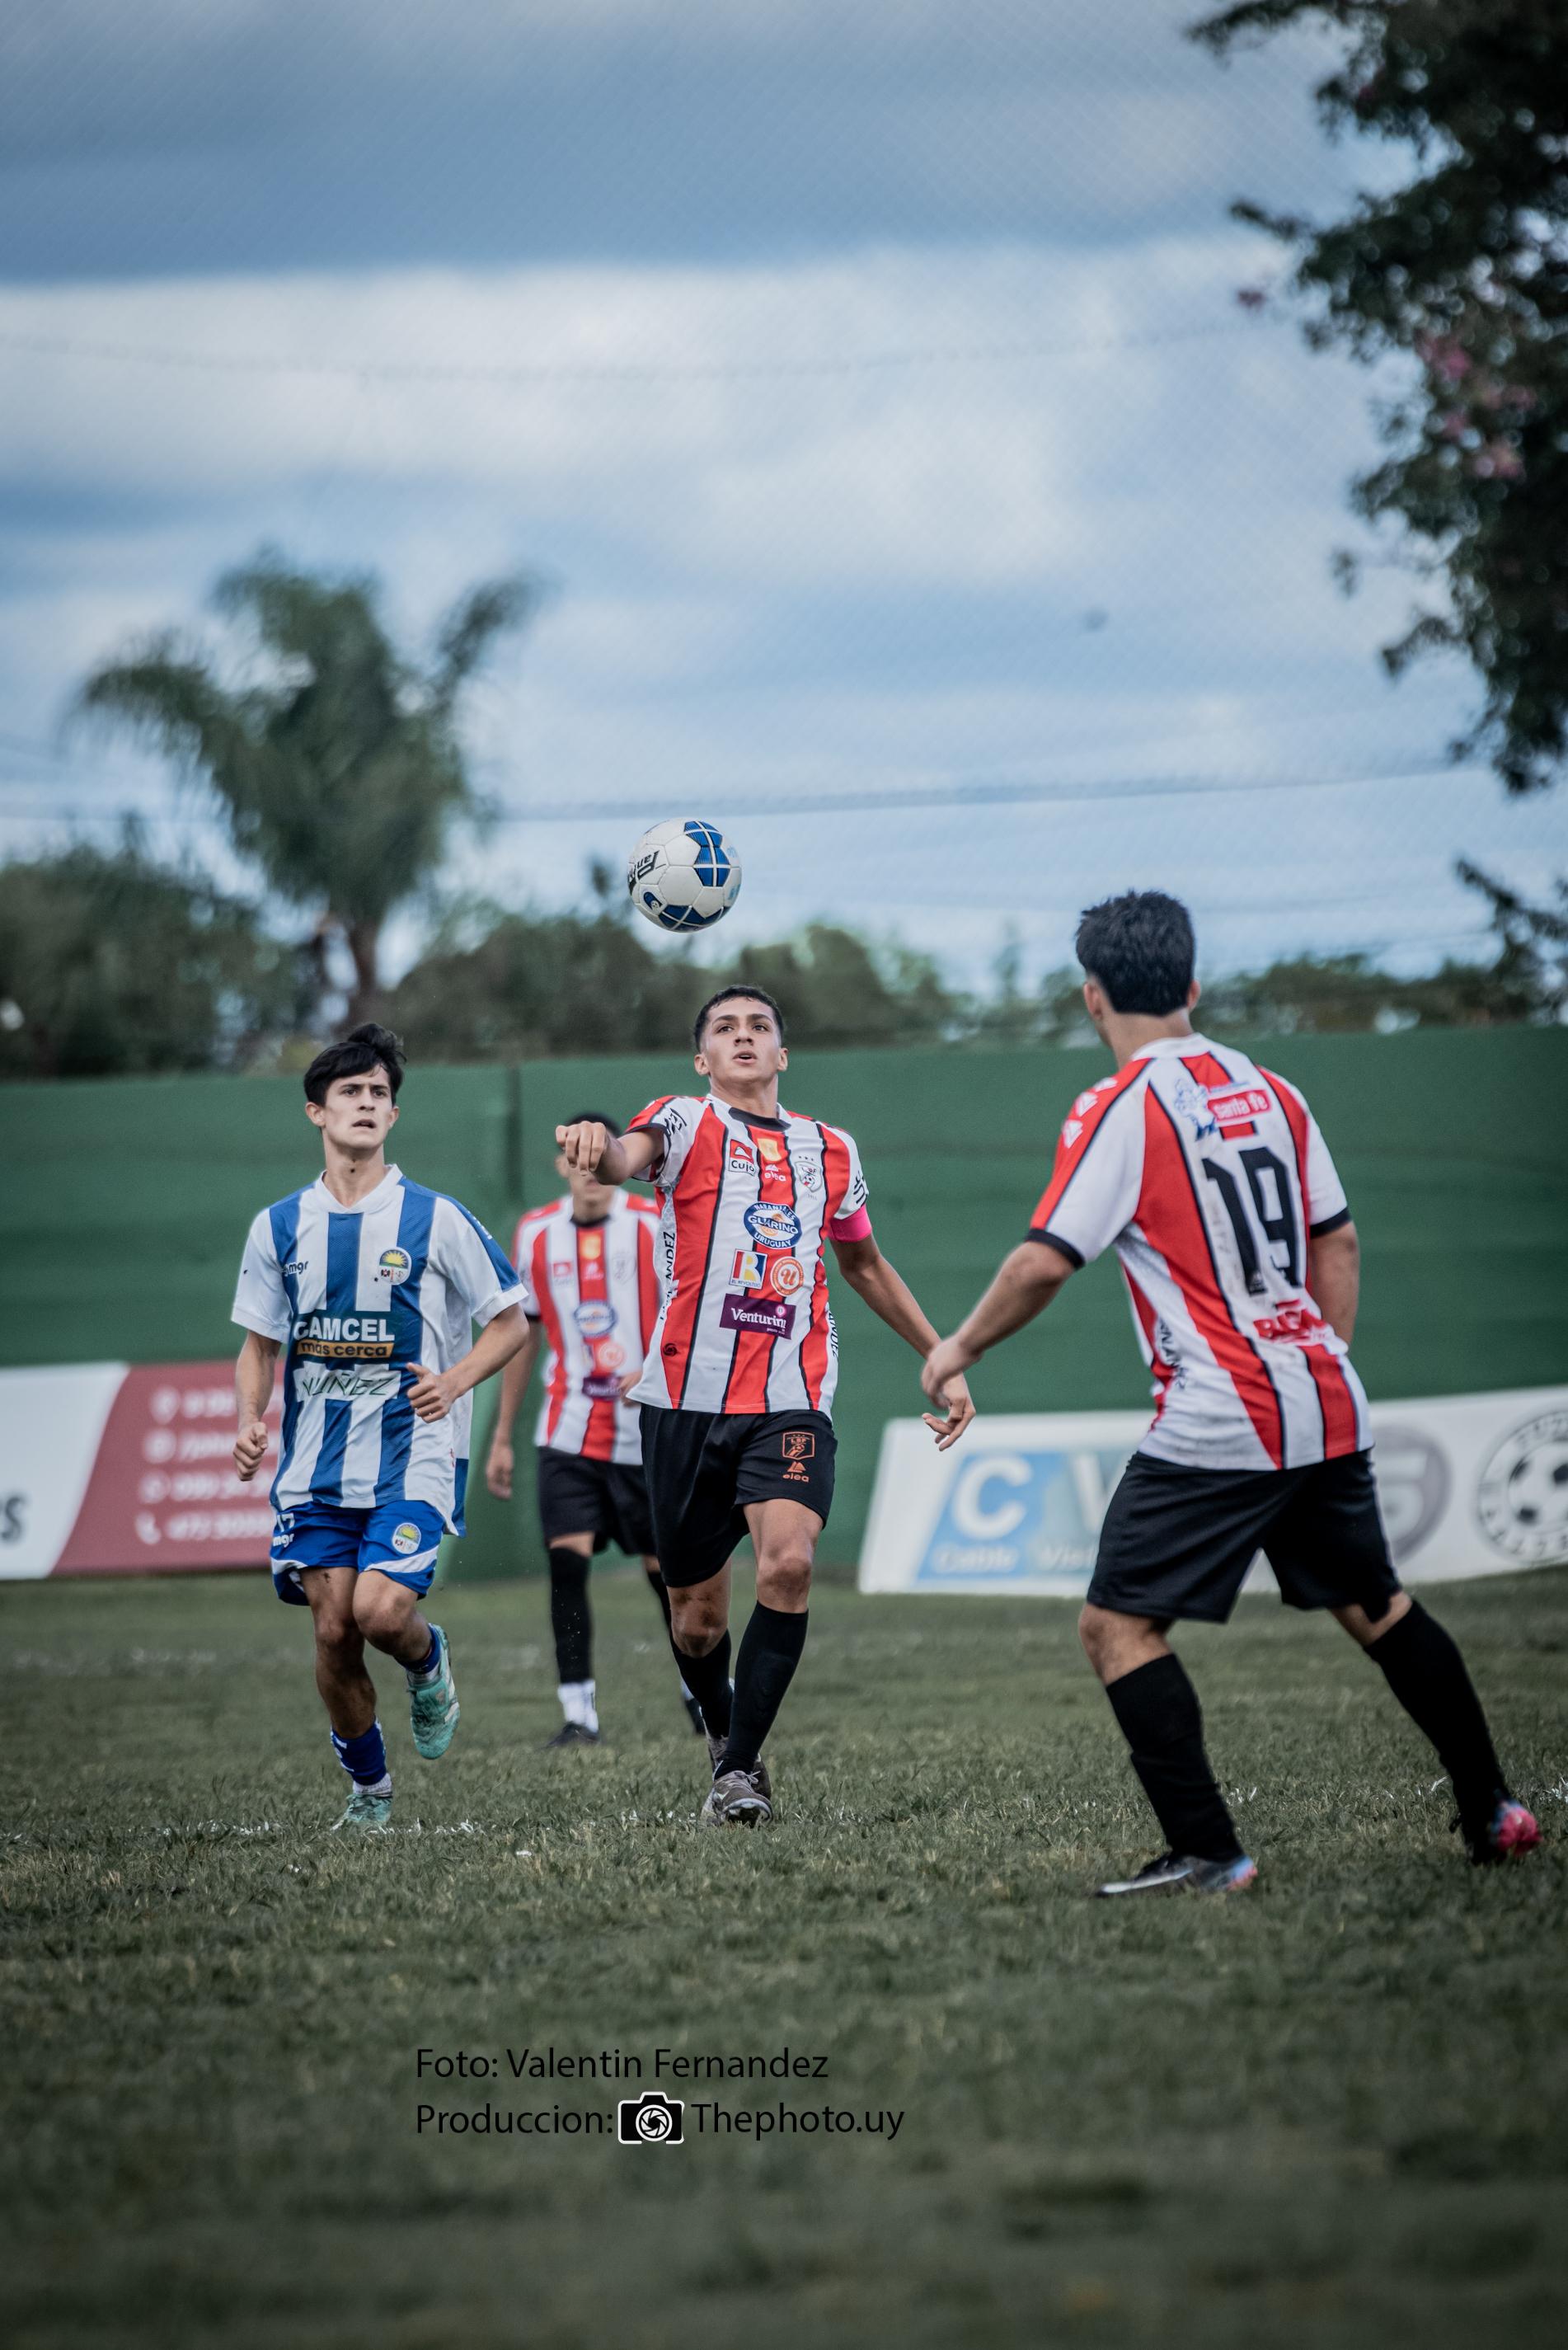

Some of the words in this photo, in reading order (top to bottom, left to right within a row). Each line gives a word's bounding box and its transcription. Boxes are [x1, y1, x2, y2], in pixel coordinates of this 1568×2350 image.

[748, 1215, 799, 1234] GUARINO
[1201, 1146, 1303, 1297] 19
[753, 1232, 792, 1248] URUGUAY
[334, 1345, 387, 1357] cerca
